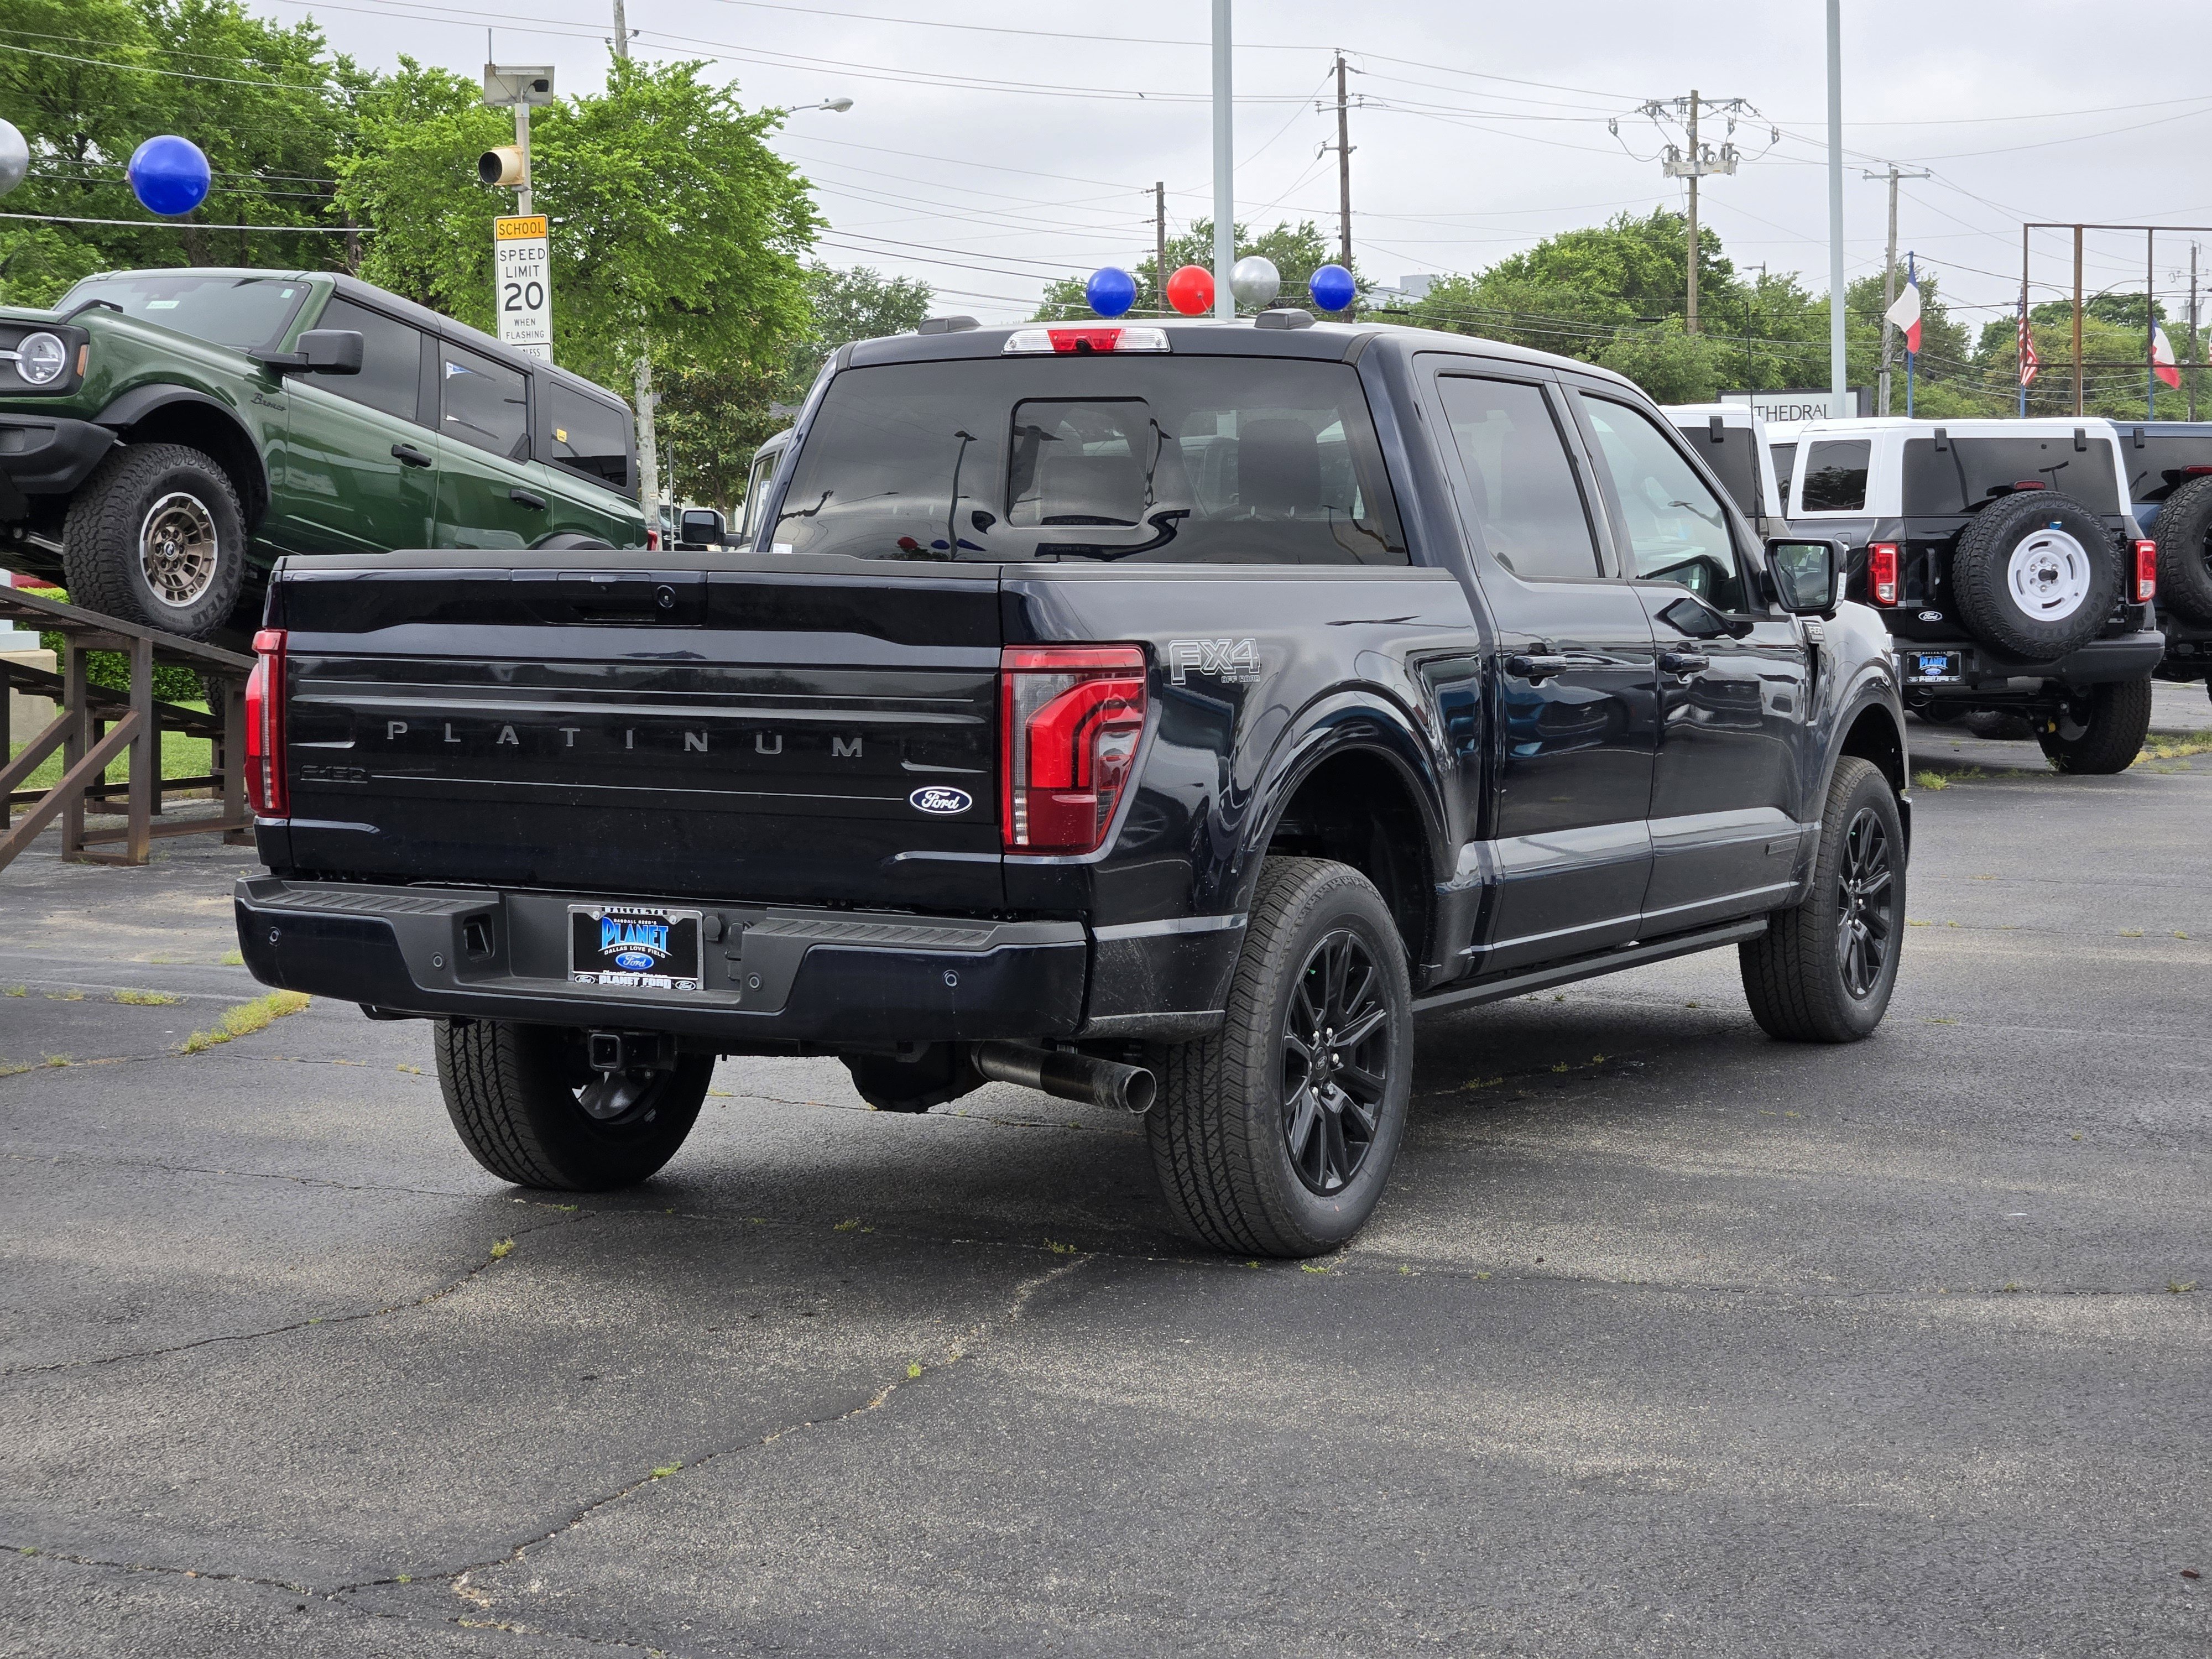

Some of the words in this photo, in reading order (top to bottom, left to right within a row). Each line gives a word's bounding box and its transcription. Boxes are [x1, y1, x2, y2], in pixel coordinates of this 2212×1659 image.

[499, 222, 545, 236] SCHOOL
[499, 248, 546, 262] SPEED
[505, 265, 540, 278] LIMIT
[504, 281, 544, 311] 20
[514, 318, 536, 326] WHEN
[506, 330, 544, 340] FLASHING
[1753, 404, 1832, 422] THEDRAL
[1168, 638, 1261, 685] FX4
[387, 721, 862, 758] PLATINUM
[602, 916, 669, 952] PLANET
[604, 946, 628, 955] DALLAS
[648, 948, 666, 959] FIELD
[598, 975, 640, 986] PLANET
[642, 978, 672, 989] FORD
